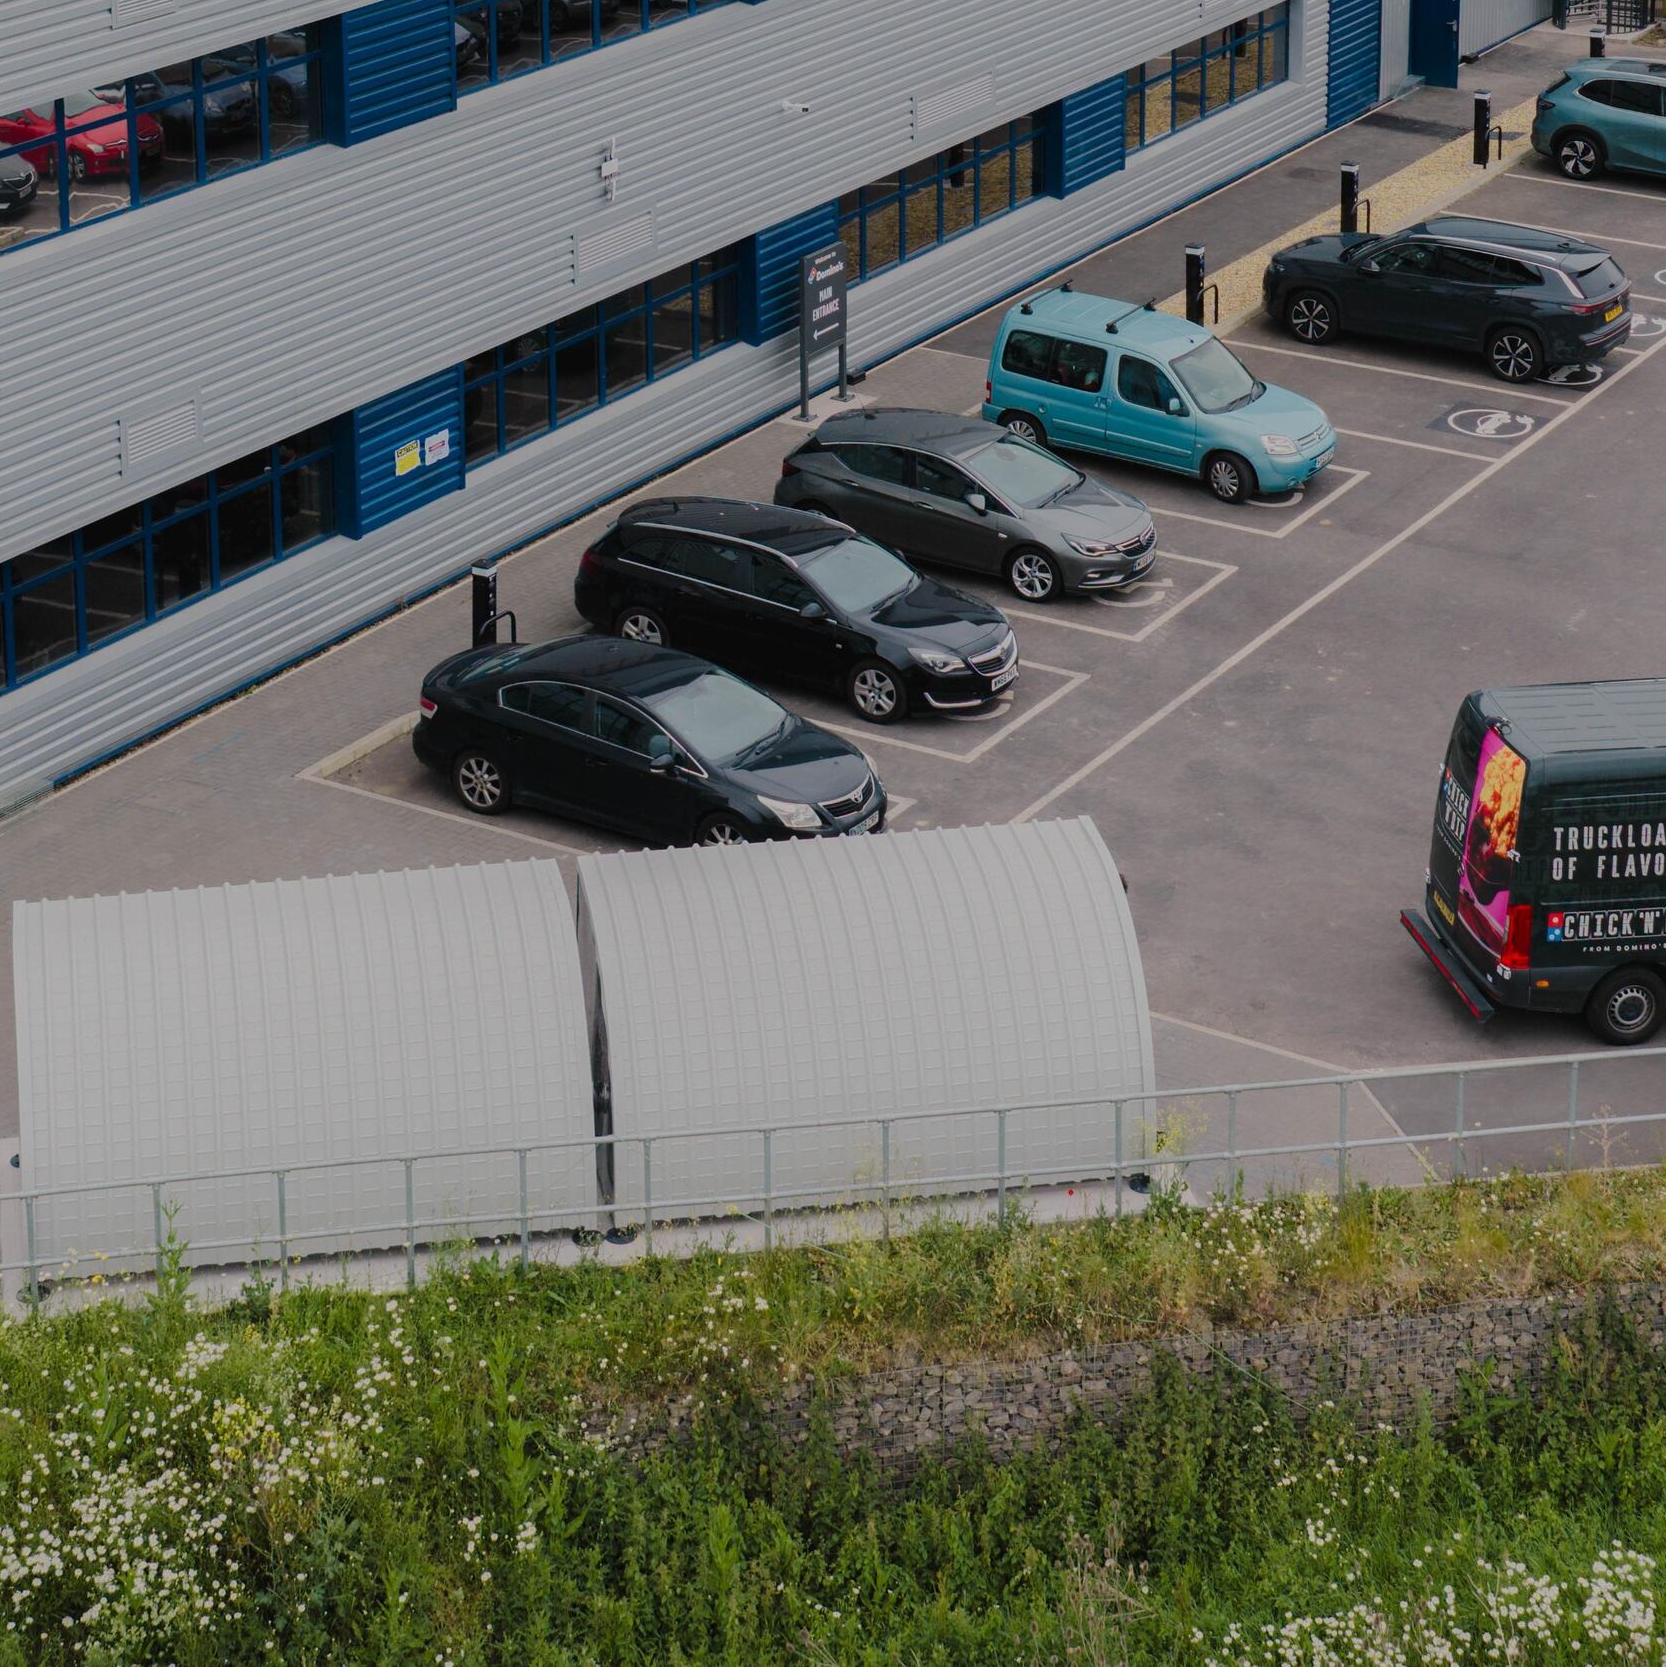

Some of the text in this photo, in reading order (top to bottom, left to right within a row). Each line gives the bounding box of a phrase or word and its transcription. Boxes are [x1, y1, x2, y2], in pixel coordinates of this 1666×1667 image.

[816, 261, 844, 282] Domino's
[819, 285, 833, 303] MAIN
[812, 297, 840, 322] ENTRANCE
[1552, 856, 1577, 881] OF
